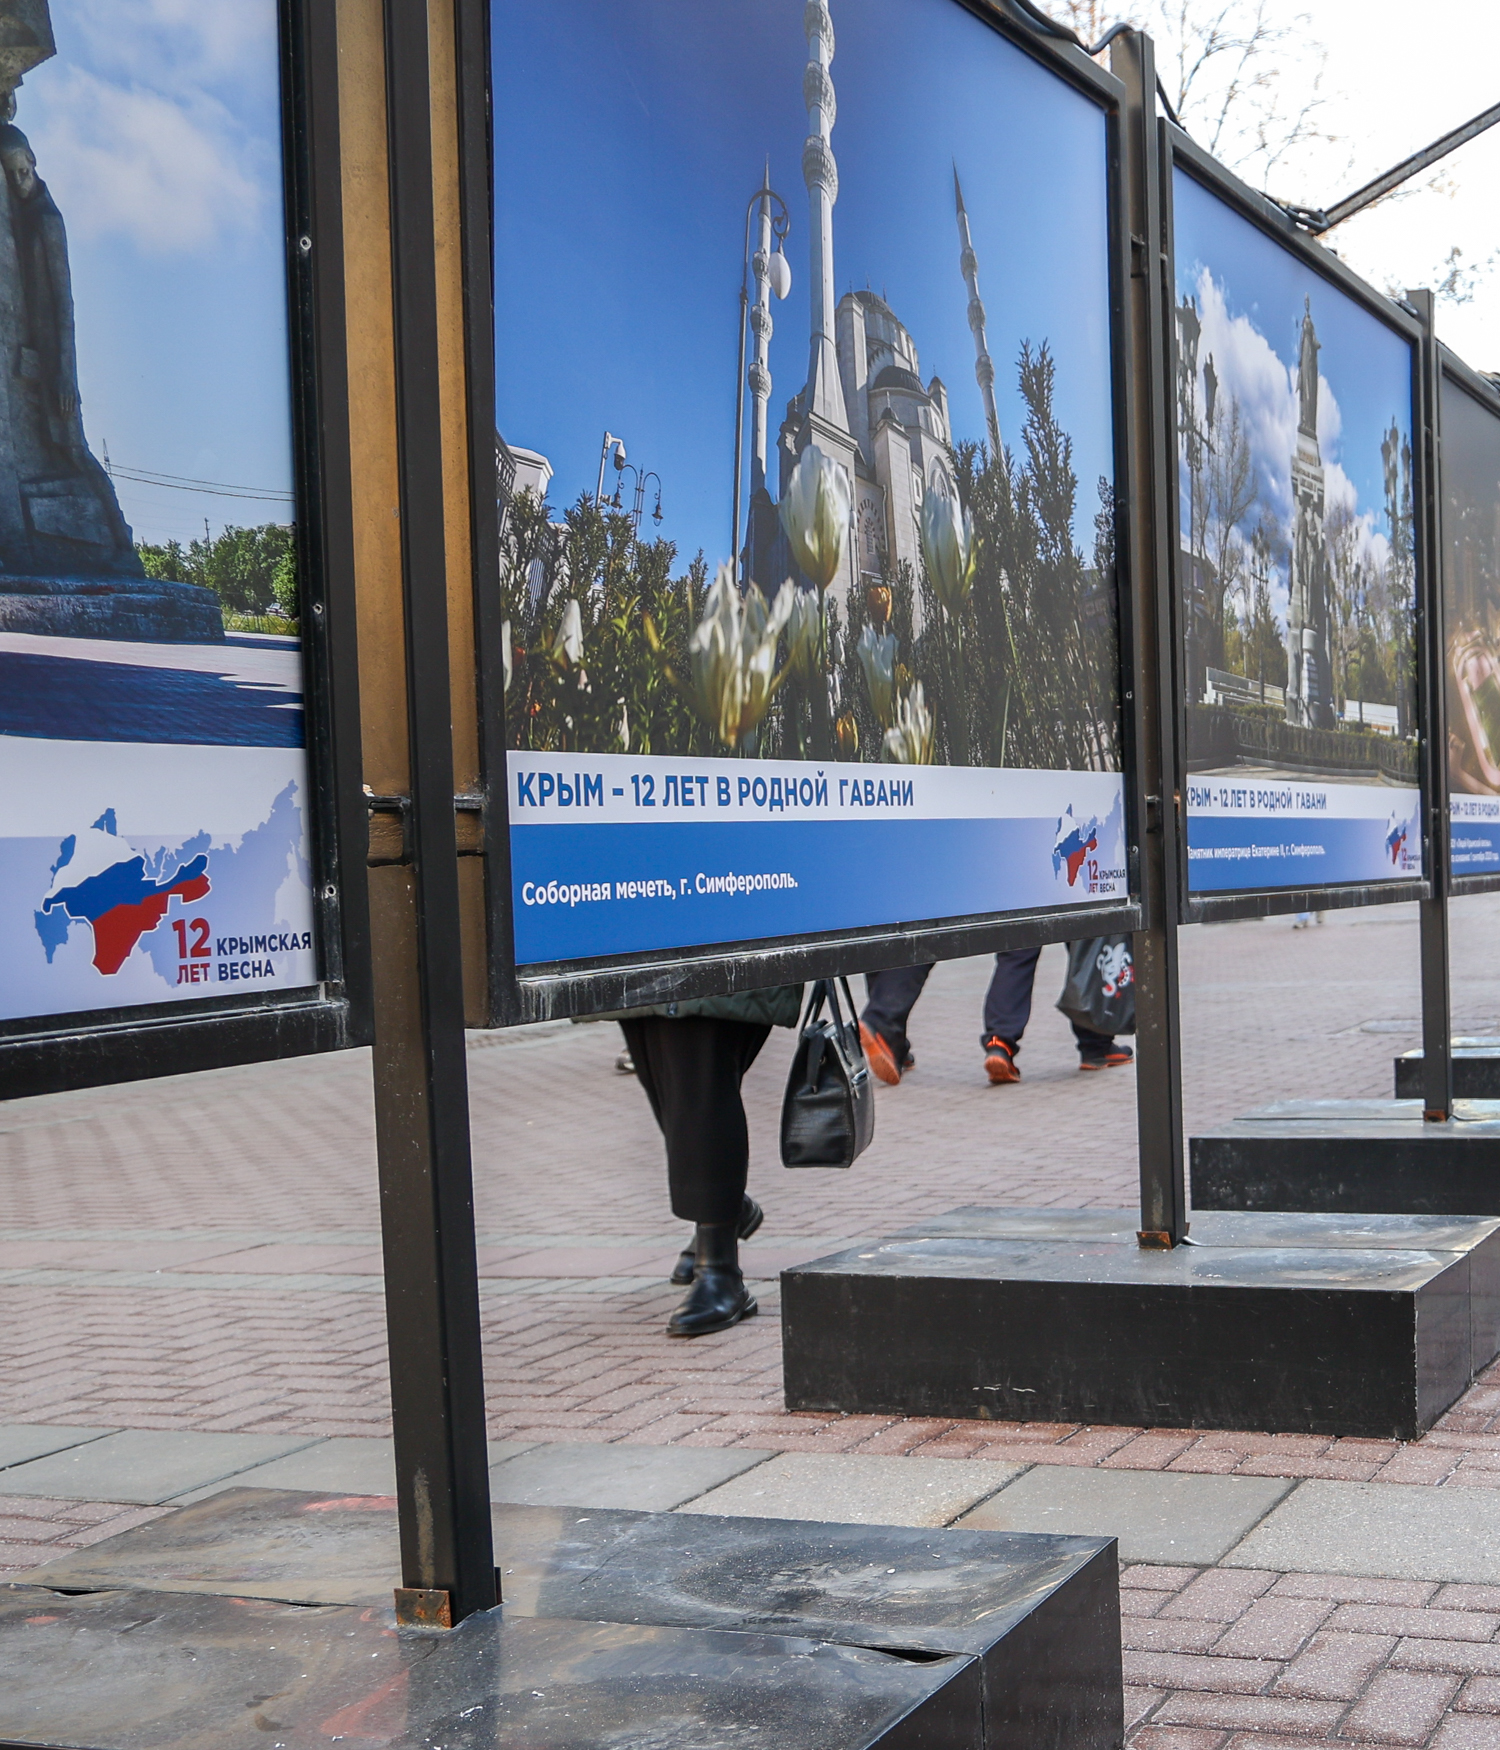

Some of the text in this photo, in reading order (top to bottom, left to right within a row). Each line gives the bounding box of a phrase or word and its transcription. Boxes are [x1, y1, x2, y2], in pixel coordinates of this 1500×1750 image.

[517, 771, 604, 807] КРЫМ
[631, 773, 656, 807] 12
[662, 775, 709, 808] ЛЕТ
[717, 776, 731, 807] В
[738, 770, 828, 812] РОДНОЙ
[838, 778, 915, 807] ГАВАНИ
[1219, 788, 1229, 808] 12
[1230, 789, 1247, 808] ЛЕТ
[1249, 790, 1256, 809] В
[1257, 787, 1293, 812] РОДНОЙ
[1296, 791, 1327, 810] ГАВАНИ
[1087, 859, 1126, 881] 12 КРЫМСКАЯ
[522, 868, 799, 908] Соборная мечеть, г. Симферополь.
[1088, 883, 1116, 894] ЛЕТ ВЕСНА
[172, 917, 312, 960] 12 КРЫМСКАЯ
[176, 960, 275, 984] ЛЕТ ВЕСНА
